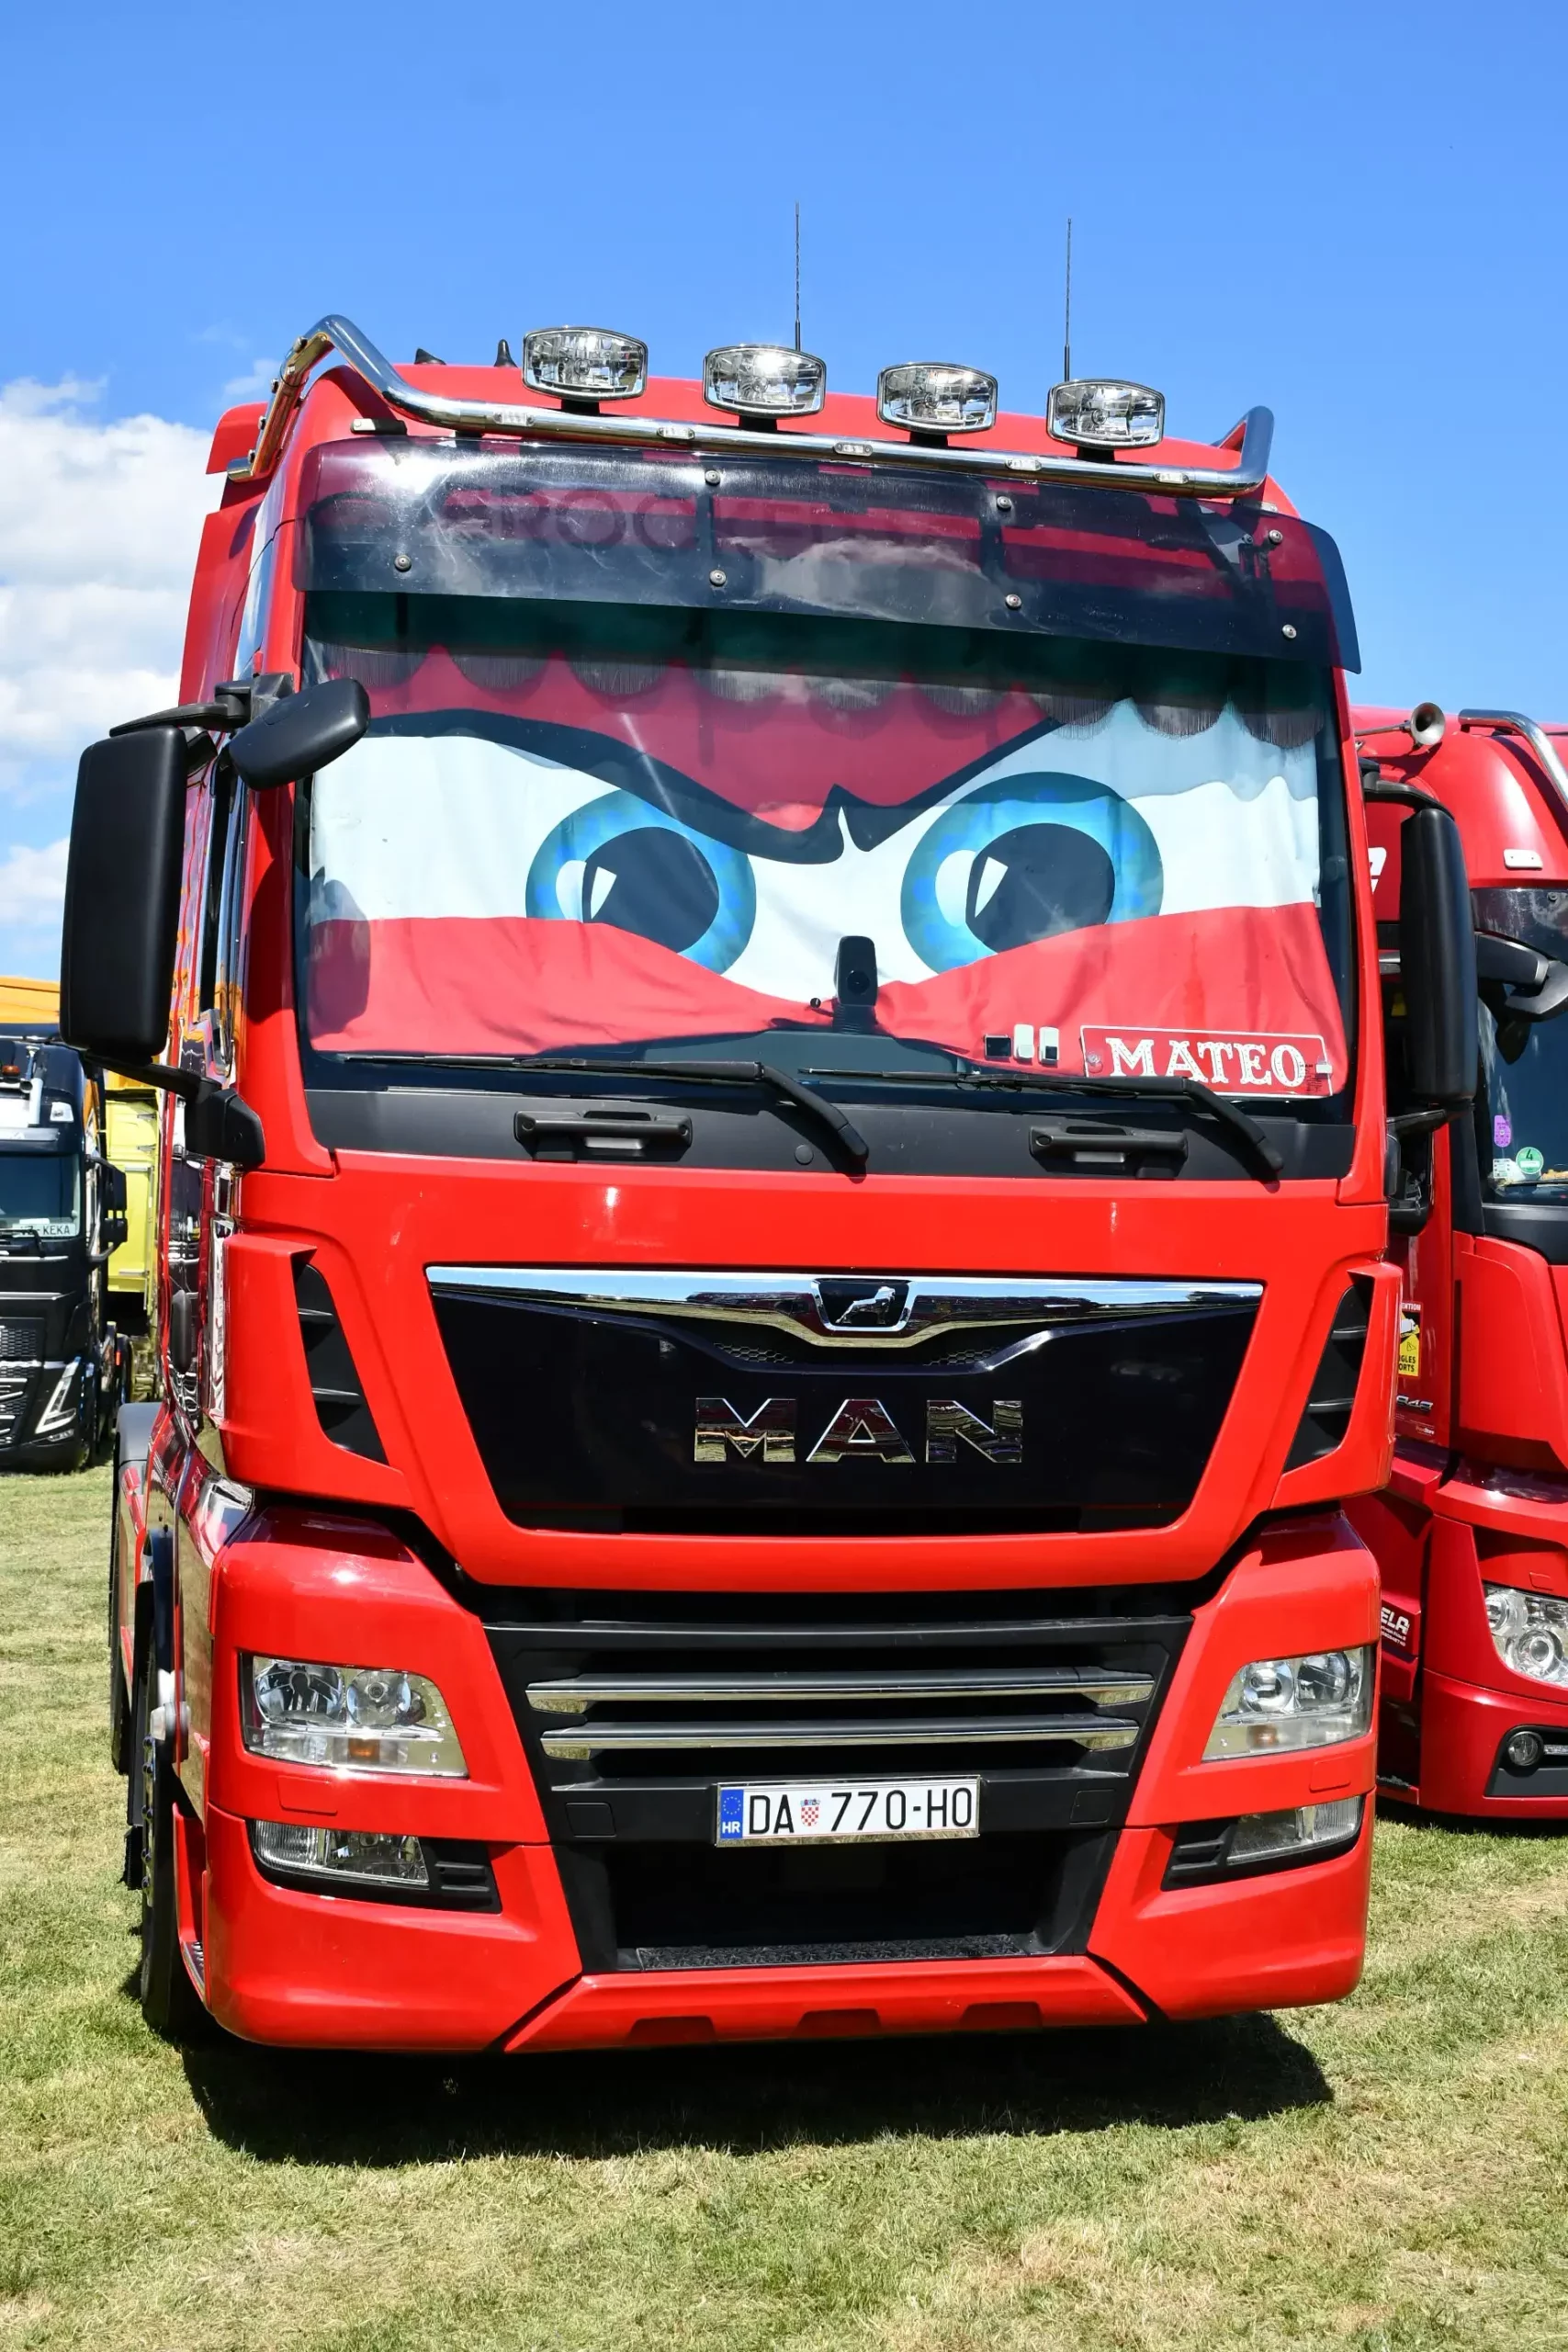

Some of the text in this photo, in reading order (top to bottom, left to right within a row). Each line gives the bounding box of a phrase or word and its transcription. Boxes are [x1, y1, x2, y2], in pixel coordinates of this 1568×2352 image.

[1105, 1037, 1306, 1088] MATEO
[1526, 1148, 1533, 1161] 4
[694, 1397, 1023, 1463] MAN
[722, 1787, 974, 1835] HR DA 770-HO
